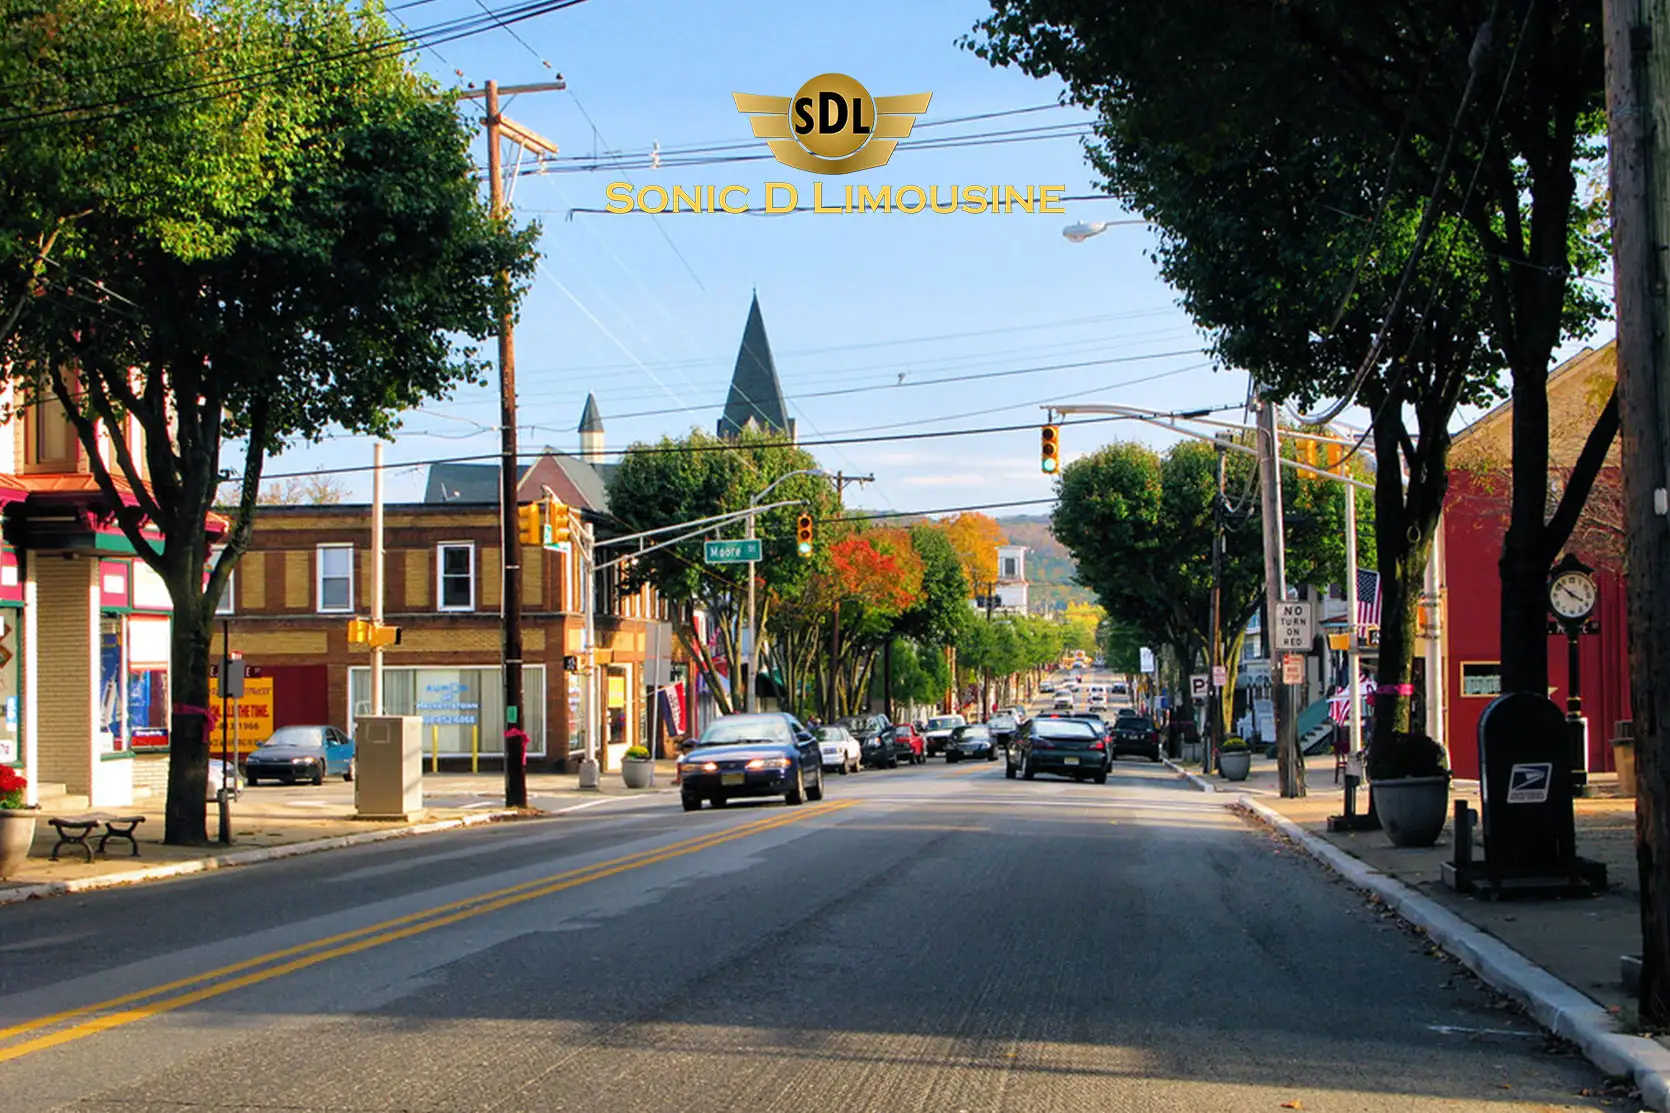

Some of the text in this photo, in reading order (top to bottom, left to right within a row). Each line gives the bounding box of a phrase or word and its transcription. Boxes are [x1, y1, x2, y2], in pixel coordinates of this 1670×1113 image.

[710, 546, 741, 557] Moore
[1284, 606, 1303, 616] NO
[1281, 618, 1306, 626] TURN
[1286, 628, 1300, 636] ON
[1283, 638, 1303, 646] RED
